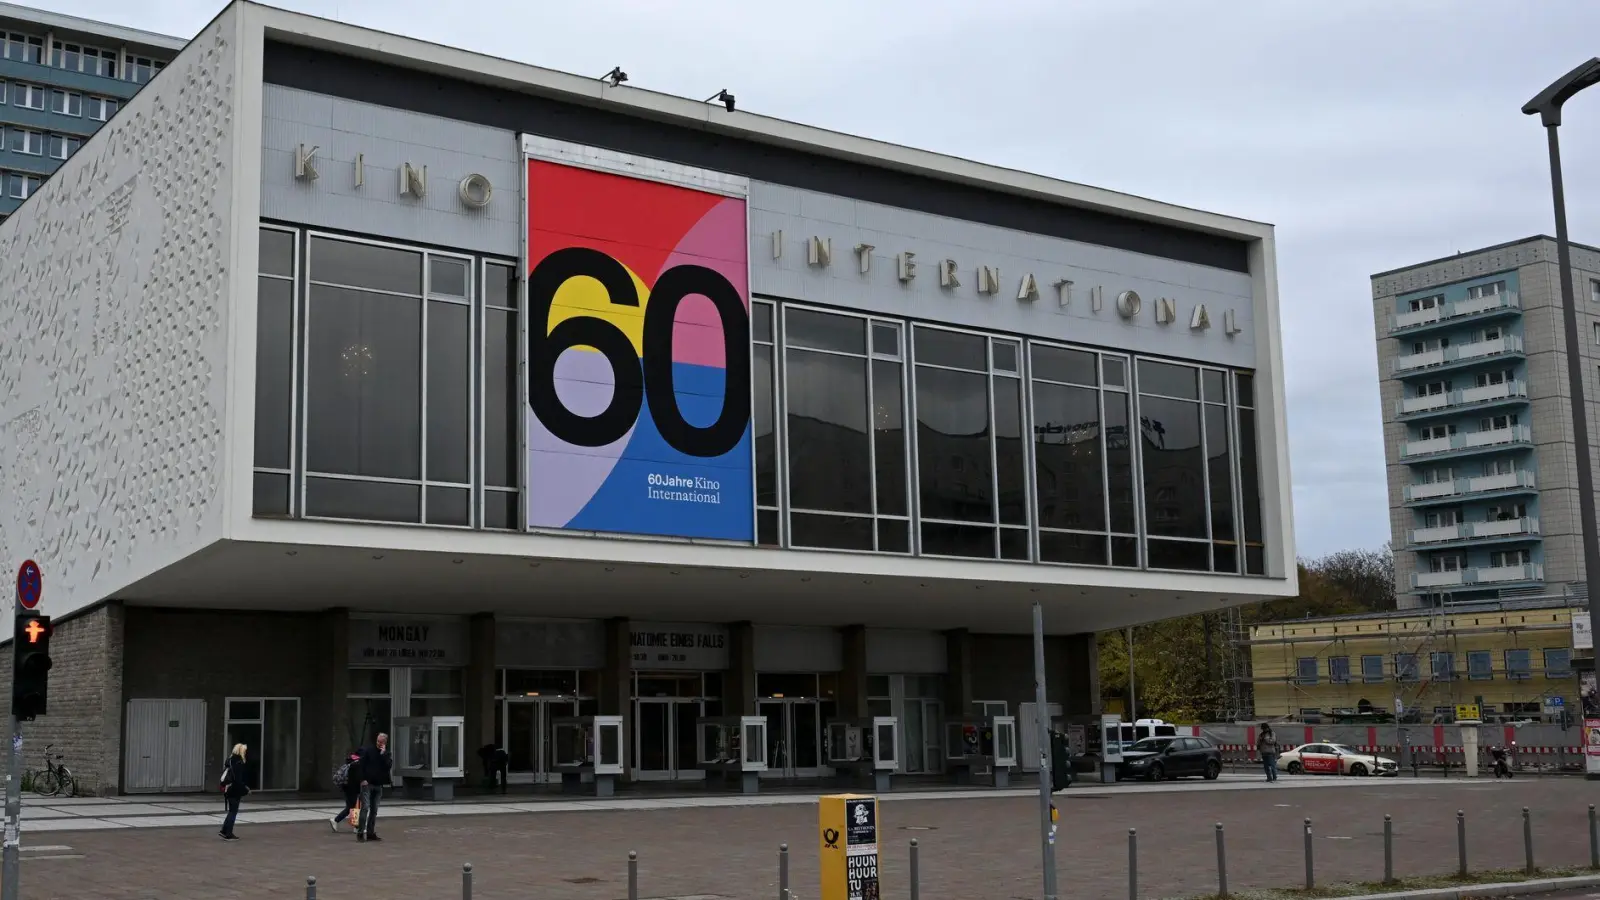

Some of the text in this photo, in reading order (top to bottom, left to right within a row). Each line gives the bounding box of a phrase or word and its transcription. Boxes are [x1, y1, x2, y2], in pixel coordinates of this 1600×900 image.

[294, 143, 492, 208] KINO
[771, 229, 1241, 339] INTERNATIONAL
[529, 247, 750, 458] 60
[648, 473, 720, 490] 60 Jahre Kino
[648, 486, 720, 504] International
[697, 633, 724, 649] FALLS
[848, 855, 876, 868] HUUN
[848, 866, 877, 880] HUUR
[849, 879, 861, 891] TU
